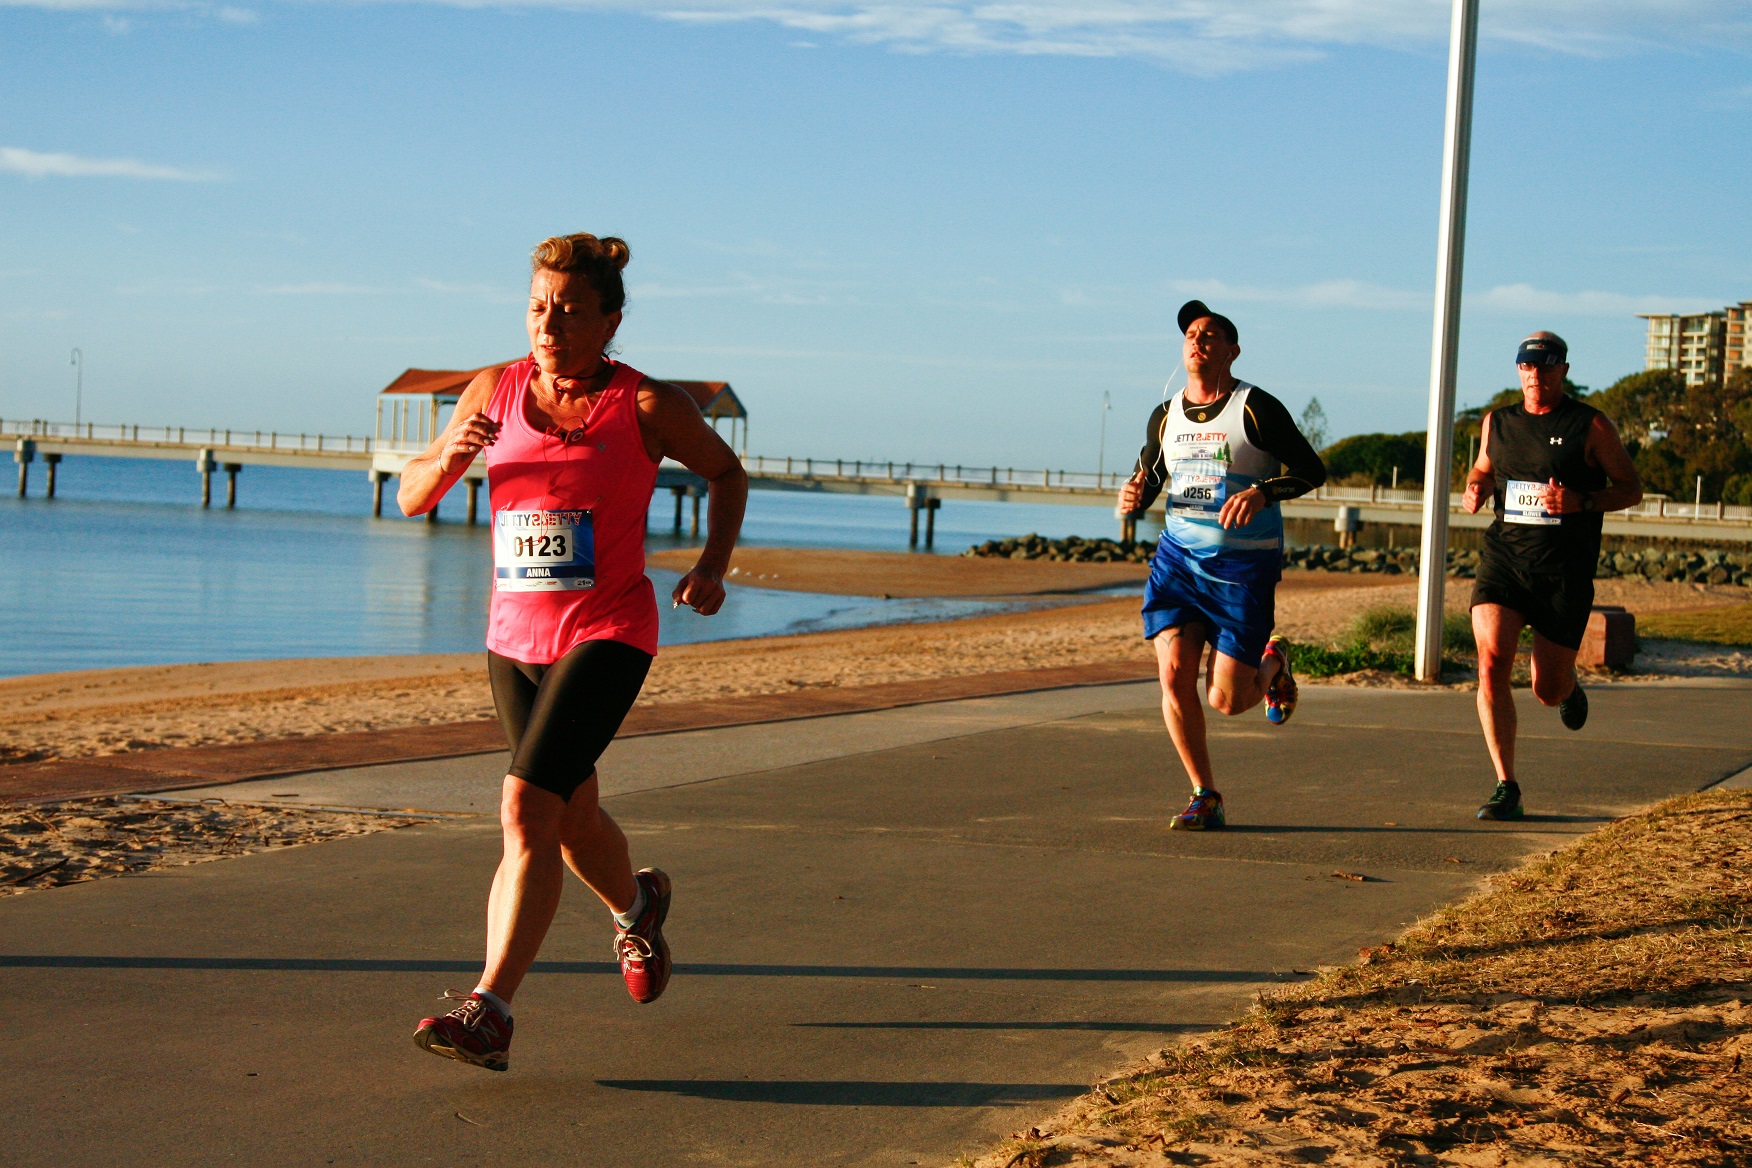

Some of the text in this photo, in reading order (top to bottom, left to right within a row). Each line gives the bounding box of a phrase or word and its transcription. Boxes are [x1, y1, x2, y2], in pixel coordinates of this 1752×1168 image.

[1183, 487, 1212, 500] 0256
[1518, 494, 1544, 507] 037
[513, 535, 567, 557] 0123
[526, 568, 551, 578] ANNA
